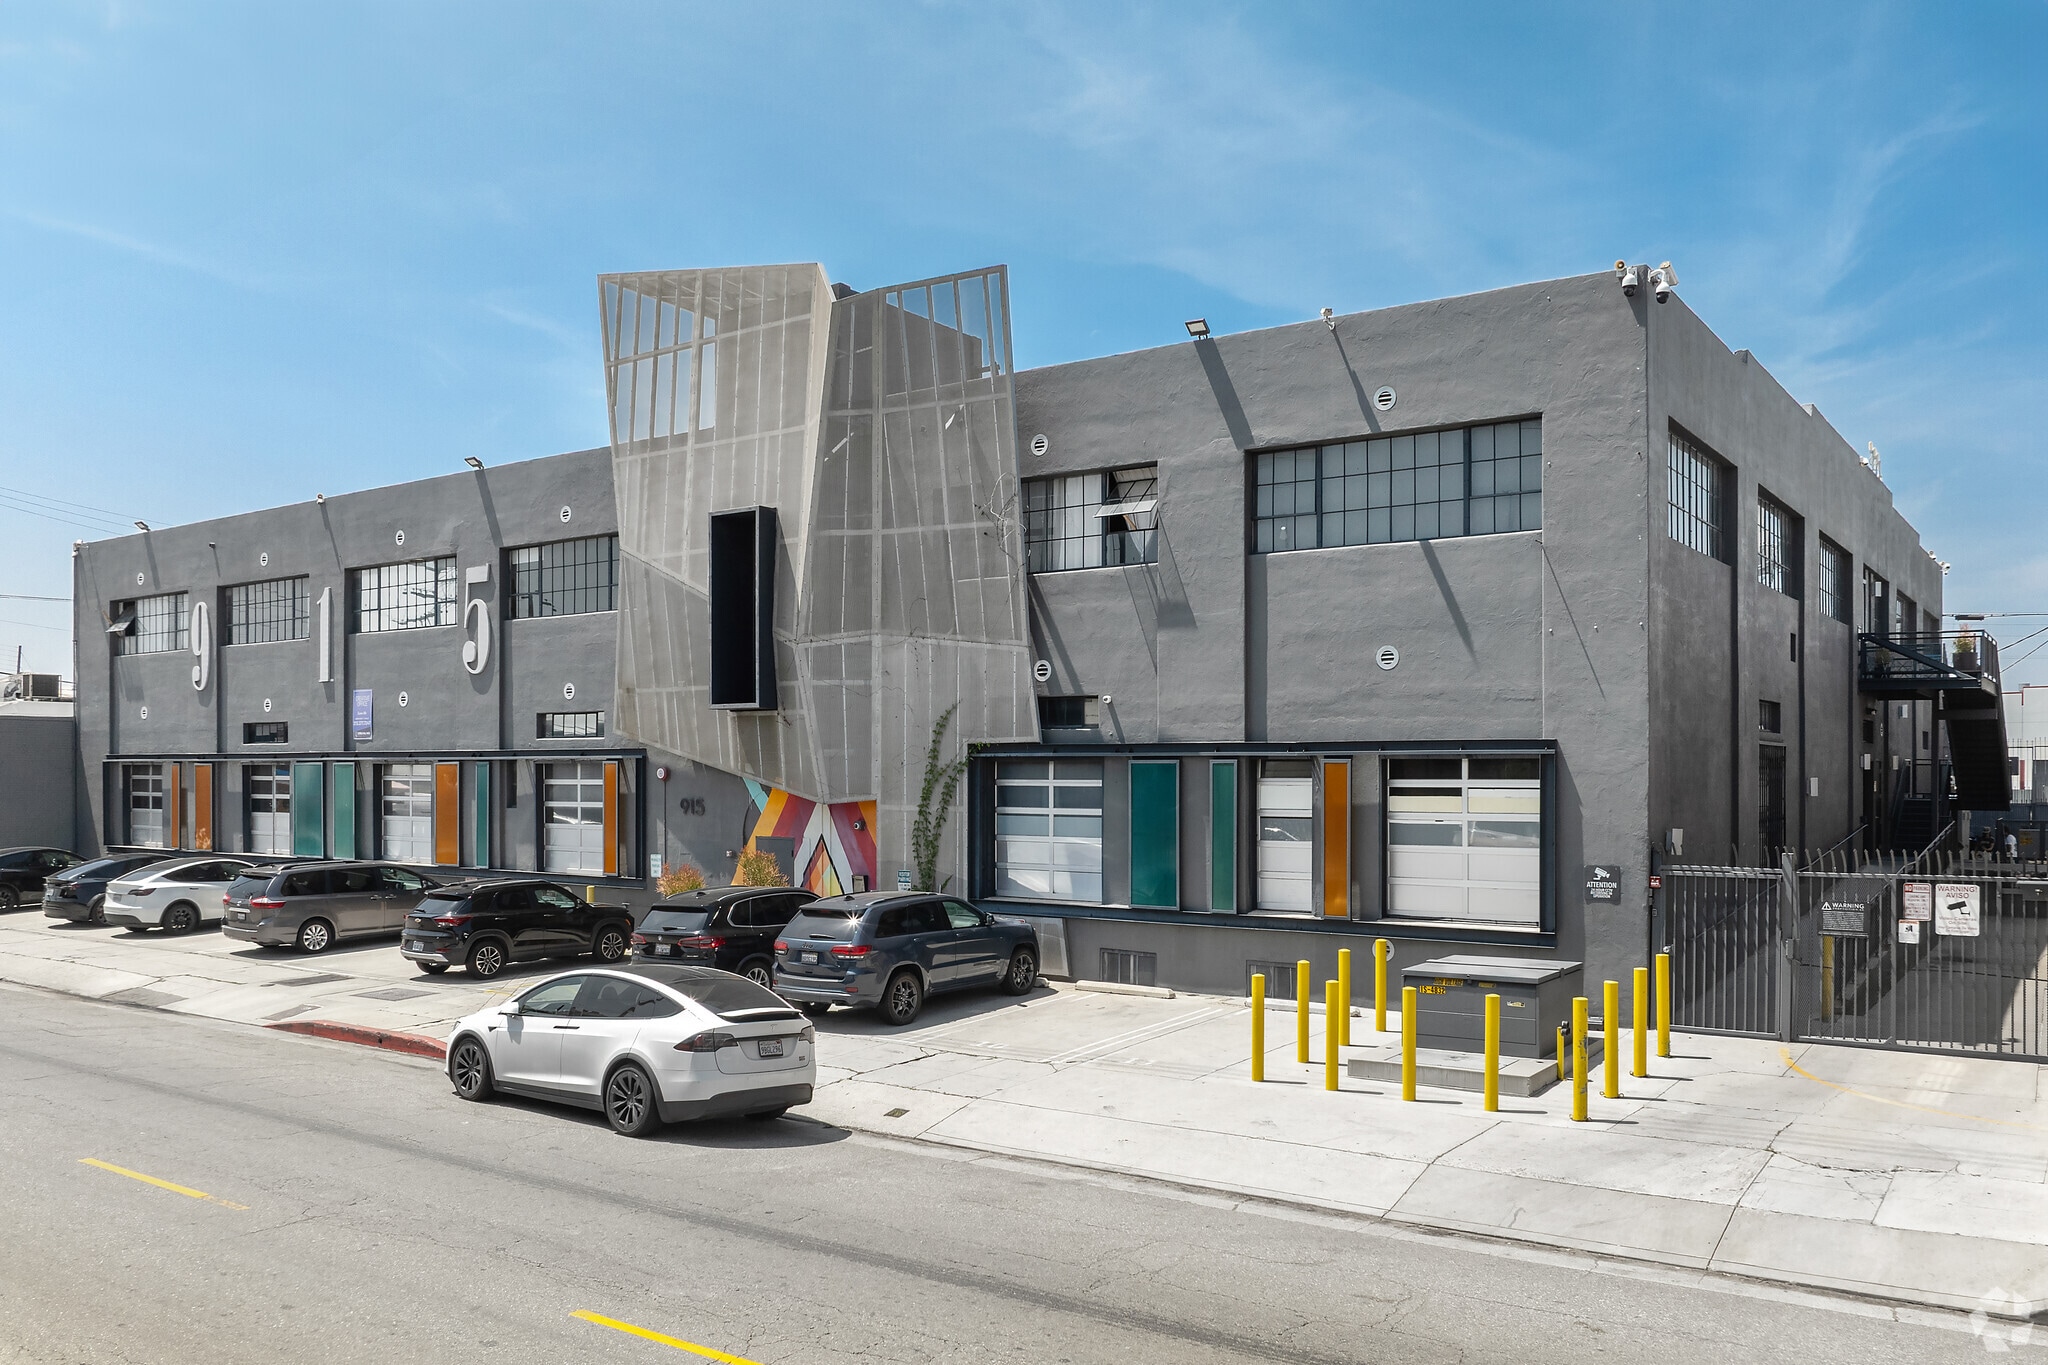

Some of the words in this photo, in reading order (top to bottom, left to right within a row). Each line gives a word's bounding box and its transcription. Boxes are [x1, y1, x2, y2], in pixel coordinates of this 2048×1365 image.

[680, 797, 706, 817] 915
[1586, 881, 1618, 889] ATTENTION
[1937, 885, 1978, 893] WARNING!
